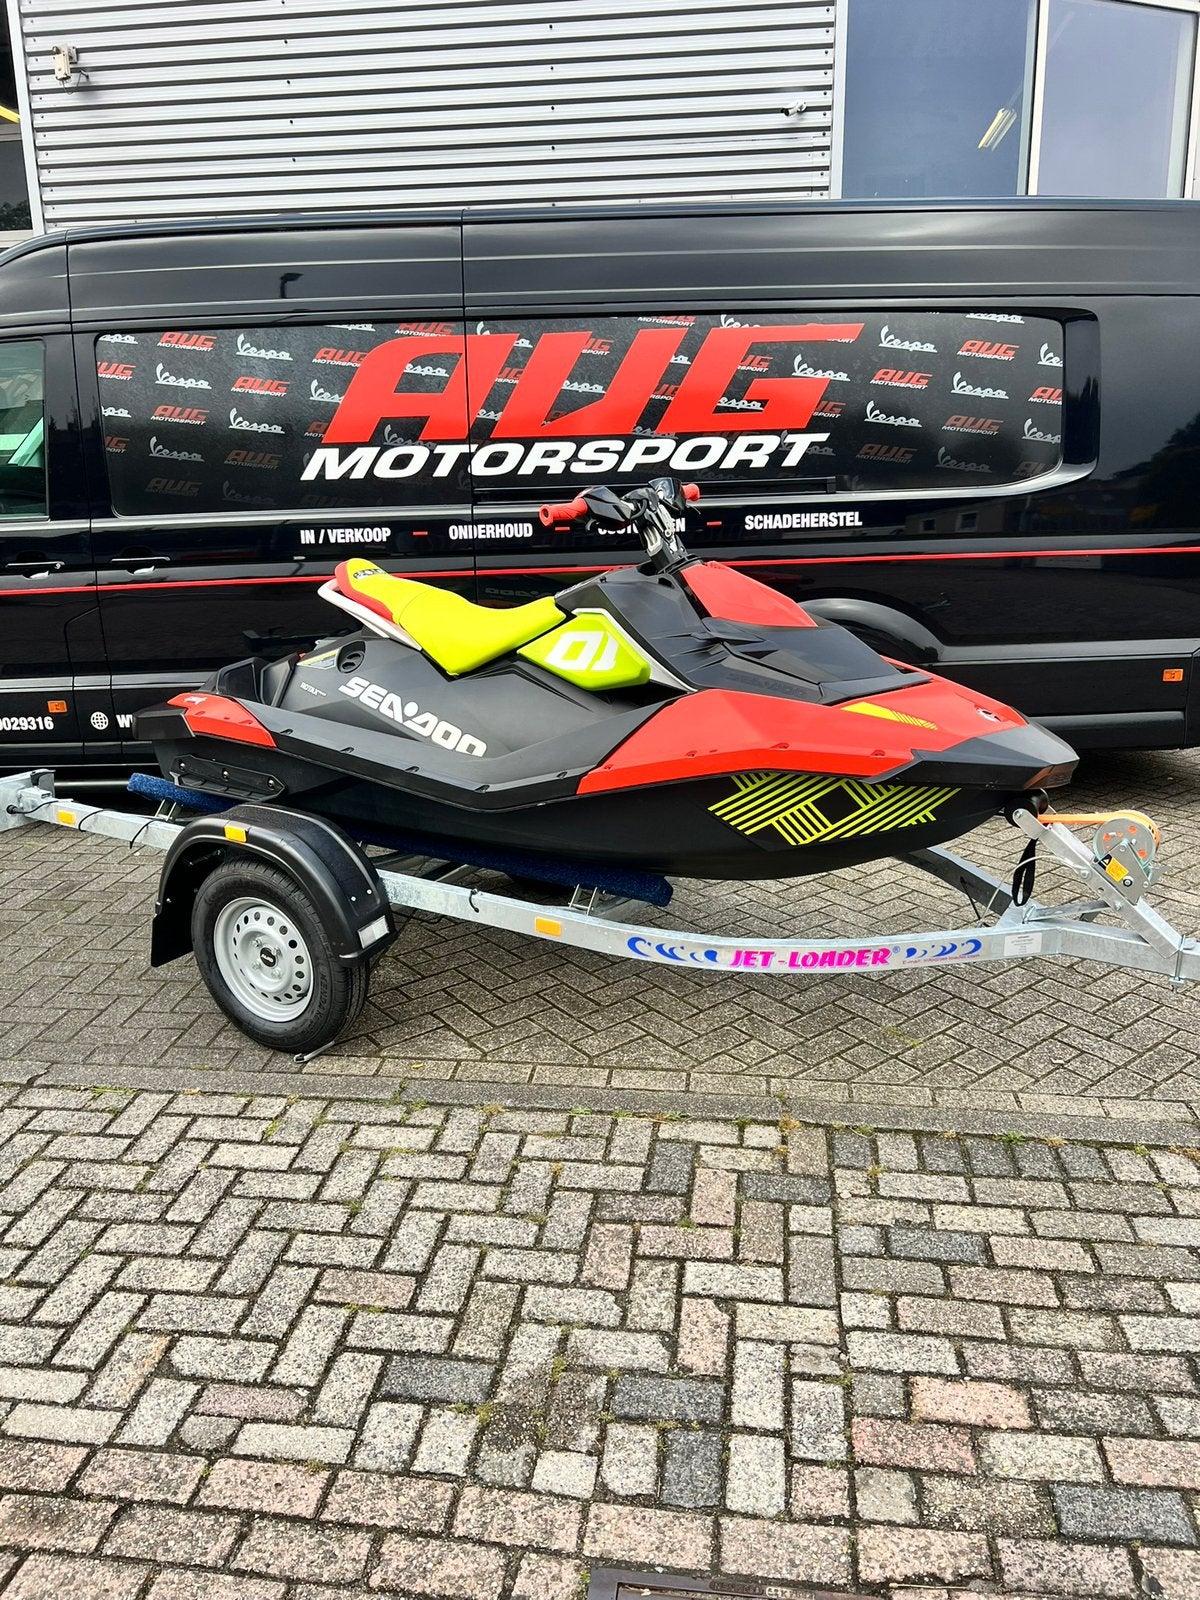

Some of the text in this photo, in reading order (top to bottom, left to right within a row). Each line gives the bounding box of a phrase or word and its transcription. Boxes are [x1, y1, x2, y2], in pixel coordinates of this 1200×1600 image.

[156, 341, 214, 352] MOTORSPORT
[159, 331, 217, 348] AUG
[236, 333, 294, 361] Vespa
[878, 324, 938, 353] Vespa
[956, 349, 1015, 361] MOTORSPORT
[959, 339, 1020, 357] AUG
[154, 362, 212, 390] Vespa
[403, 363, 450, 377] espa
[791, 353, 851, 382] Vespa
[233, 376, 290, 393] AUG
[323, 324, 864, 444] AUG
[561, 379, 607, 393] espa
[870, 378, 929, 390] MOTORSPORT
[872, 368, 933, 386] AUG
[950, 370, 1010, 400] Vespa
[230, 386, 287, 397] MOTORSPORT
[717, 396, 764, 411] espa
[150, 415, 207, 426] MOTORSPORT
[153, 405, 210, 421] AUG
[229, 407, 285, 435] Vespa
[864, 400, 923, 428] Vespa
[944, 415, 1004, 432] AUG
[148, 436, 206, 463] Vespa
[226, 449, 284, 466] AUG
[300, 432, 829, 482] MOTORSPORT
[857, 443, 918, 461] AUG
[935, 446, 994, 474] Vespa
[300, 529, 316, 545] IN
[327, 527, 392, 544] VERKOOP
[448, 523, 533, 540] ONDERHOUD
[744, 511, 863, 530] SCHADEHERSTEL
[0, 715, 54, 732] 029316
